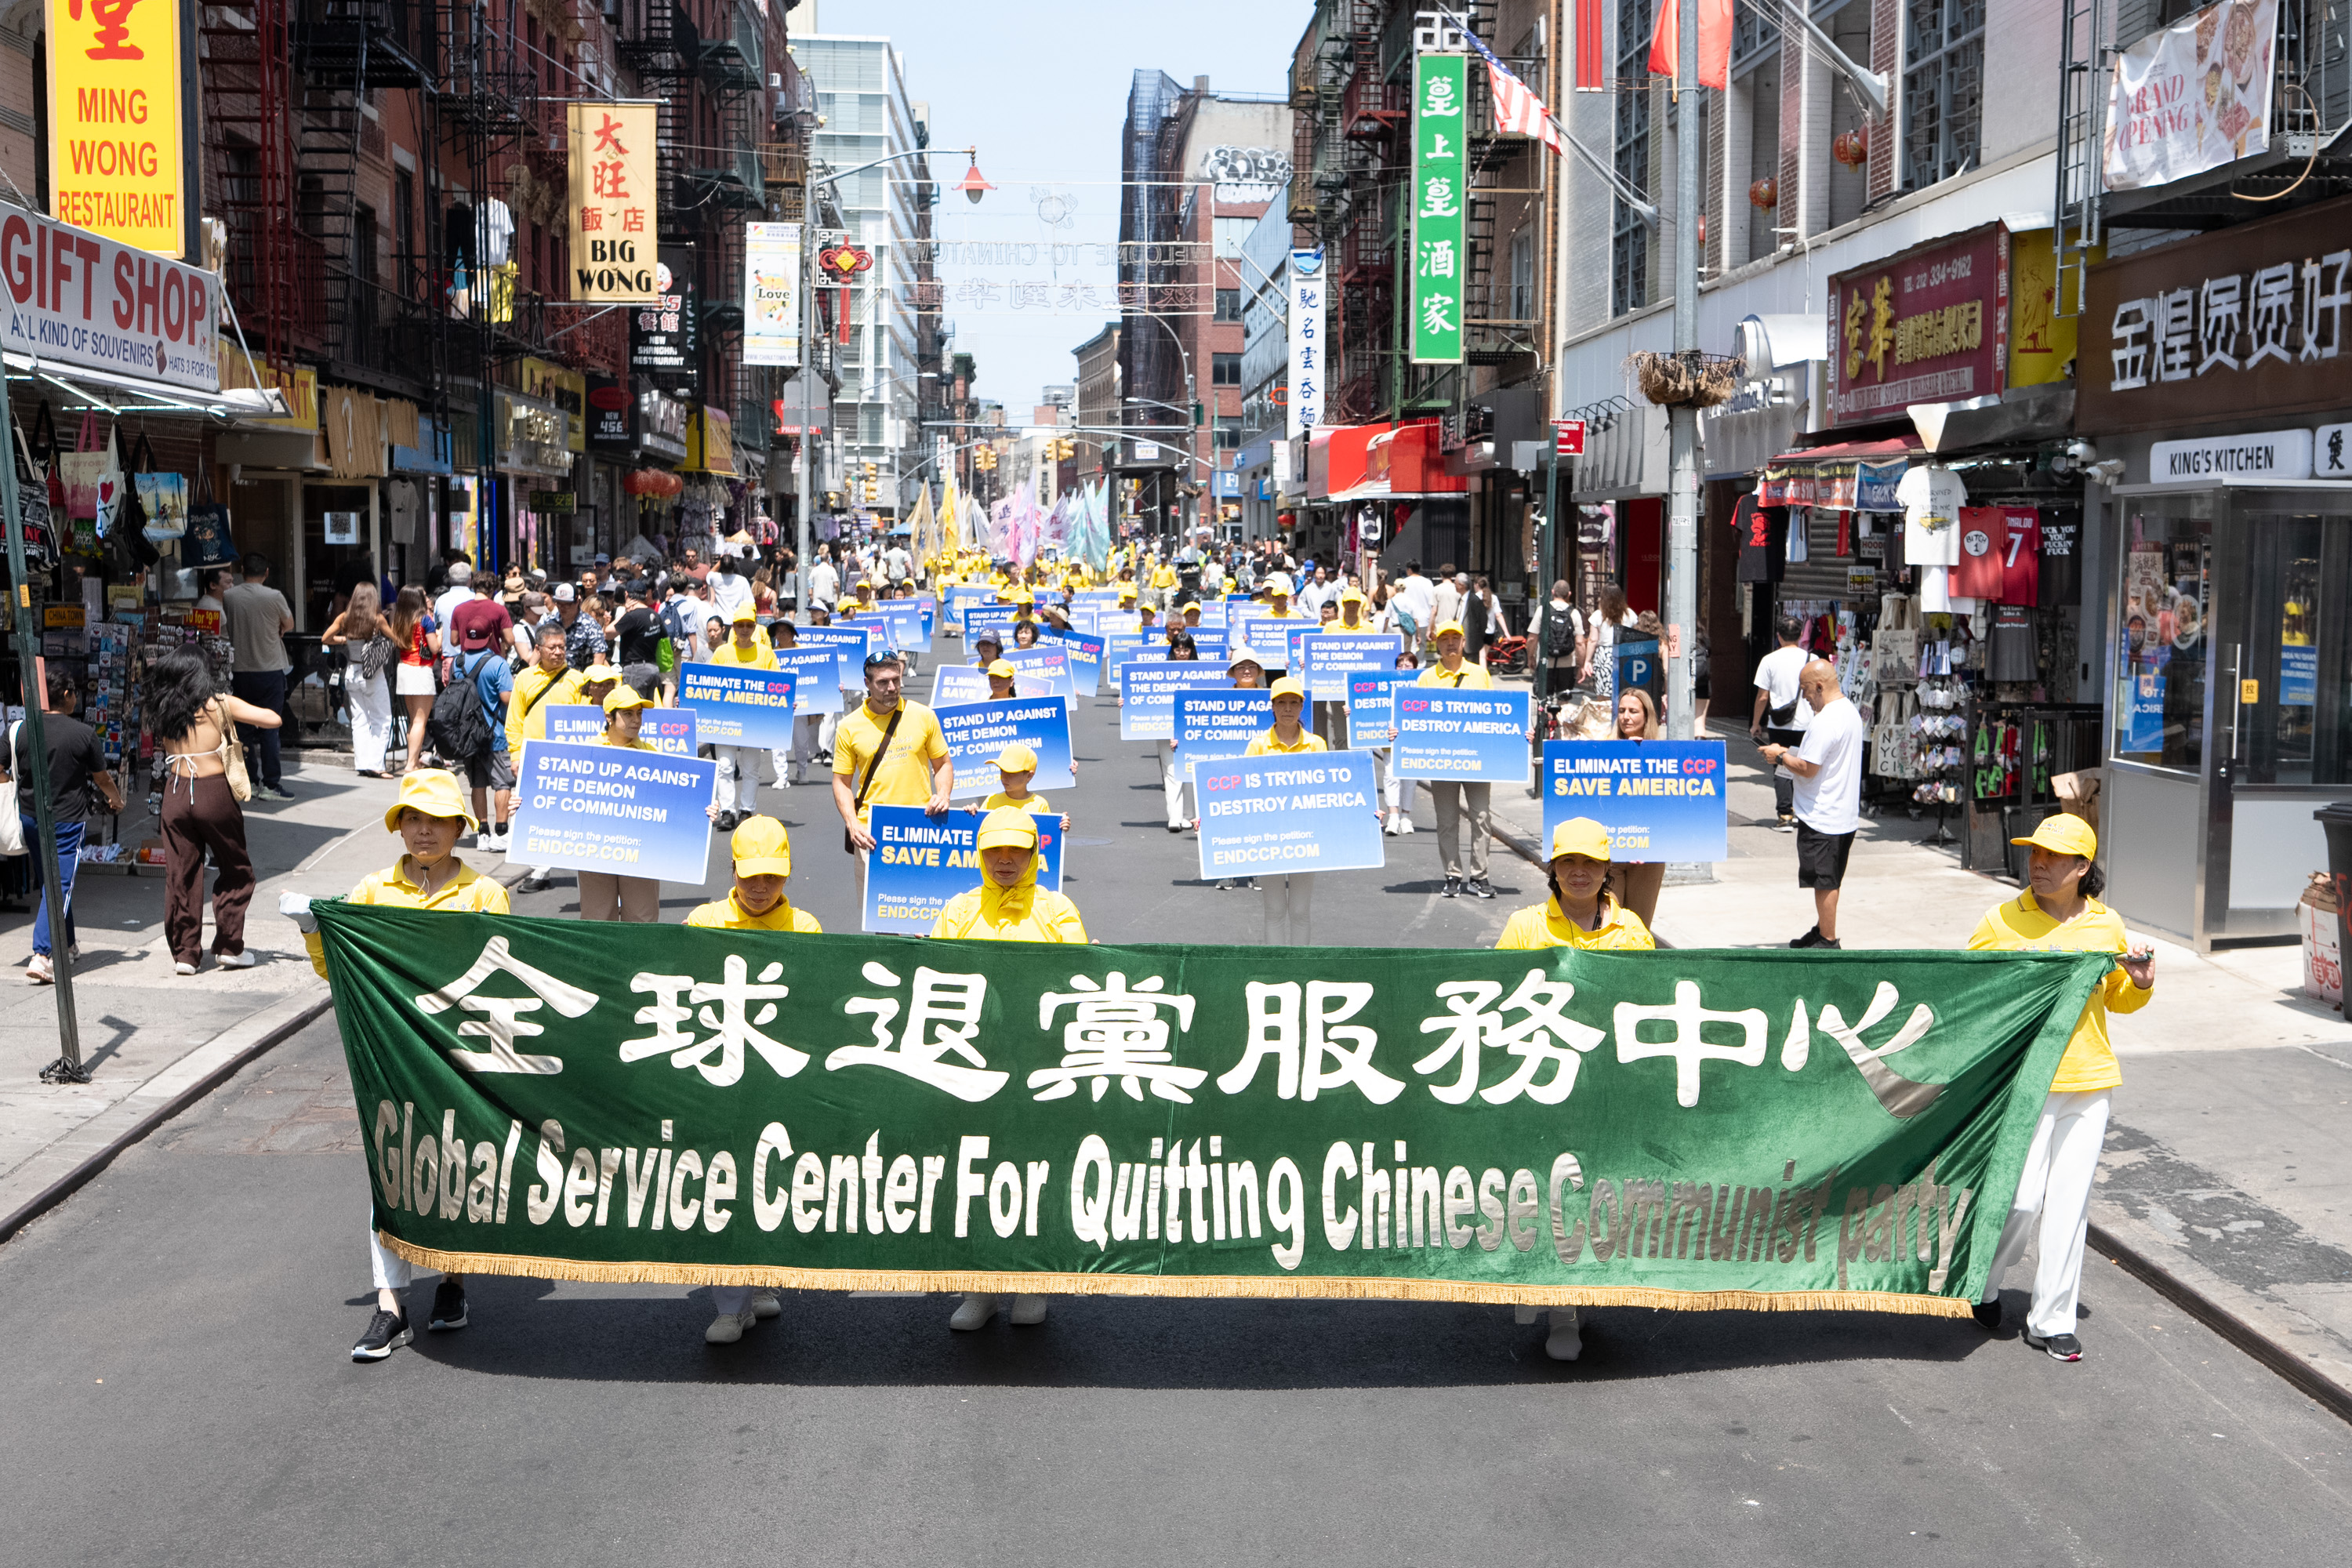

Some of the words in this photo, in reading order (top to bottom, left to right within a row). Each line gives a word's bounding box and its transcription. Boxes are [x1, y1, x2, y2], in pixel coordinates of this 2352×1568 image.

[2125, 74, 2184, 118] GRAND
[78, 88, 147, 124] MING
[71, 140, 157, 176] WONG
[592, 113, 630, 199] 大旺
[60, 191, 174, 227] RESTAURANT
[580, 206, 644, 233] 飯店
[591, 240, 635, 263] BIG
[1916, 272, 1927, 288] 212
[1929, 254, 1972, 287] 334-9162
[1, 215, 100, 321] GIFT
[113, 250, 206, 346] SHOP
[577, 269, 652, 293] WONG
[758, 288, 790, 299] Love
[2111, 249, 2352, 391] 金煌煲煲好
[11, 314, 35, 343] ALL
[40, 318, 68, 348] KIND
[72, 327, 88, 355] OF
[92, 335, 154, 368] SOUVENIRS
[649, 336, 666, 345] NEW
[637, 346, 678, 355] SHANGHAI
[169, 355, 184, 372] HATS
[186, 359, 191, 372] 3
[191, 361, 205, 376] FOR
[206, 365, 216, 380] $10
[633, 356, 684, 366] RESTAURANT
[605, 412, 619, 420] NEW
[600, 421, 623, 432] 456
[1558, 423, 1579, 431] STANDING
[2170, 449, 2212, 475] KING'S
[2215, 445, 2274, 472] KITCHEN
[2005, 516, 2033, 528] ONALDO
[1966, 533, 1987, 543] BITCH
[1974, 543, 1979, 552] 1
[2006, 532, 2024, 568] 7
[49, 609, 66, 620] CHINA
[67, 608, 84, 620] TOWN
[194, 610, 205, 624] for
[811, 633, 822, 643] UP
[823, 634, 862, 644] AGAINST
[1065, 639, 1081, 650] THE
[1083, 643, 1101, 653] CCP
[1311, 642, 1339, 651] STAND
[1356, 642, 1395, 651] AGAINST
[792, 654, 830, 666] AGAINST
[1025, 657, 1044, 668] THE
[1045, 655, 1065, 666] CCP
[1311, 652, 1327, 661] THE
[1329, 652, 1363, 661] DEMON
[1312, 662, 1323, 671] OF
[1325, 662, 1381, 671] COMMUNISM
[1632, 659, 1647, 682] P
[686, 673, 741, 690] ELIMINATE
[744, 680, 765, 691] THE
[768, 682, 791, 694] CCP
[1130, 671, 1163, 681] STAND
[1166, 671, 1179, 681] UP
[1181, 670, 1226, 681] AGAINST
[942, 688, 976, 699] SAVE
[1130, 684, 1149, 692] THE
[1152, 683, 1190, 692] DEMON
[1354, 682, 1376, 693] CCP
[1377, 681, 1388, 691] IS
[2245, 684, 2255, 695] 拉
[684, 687, 720, 702] SAVE
[724, 690, 788, 708] AMERICA
[1184, 700, 1227, 712] STAND
[1230, 700, 1245, 712] UP
[1402, 700, 1428, 713] CCP
[1431, 700, 1443, 713] IS
[1446, 701, 1492, 715] TRYING
[1494, 702, 1512, 715] TO
[944, 713, 983, 729] STAND
[988, 712, 1005, 724] UP
[1007, 707, 1058, 722] AGAINST
[1185, 715, 1210, 727] THE
[1212, 715, 1257, 727] DEMON
[661, 723, 689, 736] CCP
[946, 730, 969, 743] THE
[972, 725, 1018, 741] DEMON
[1185, 729, 1202, 741] OF
[1401, 719, 1463, 733] DESTROY
[1465, 720, 1521, 735] AMERICA
[1401, 746, 1424, 755] Please
[1425, 747, 1439, 756] sign
[1401, 757, 1482, 771] ENDCCP.COM
[1554, 758, 1641, 773] ELIMINATE
[1645, 759, 1678, 773] THE
[1682, 759, 1716, 774] CCP
[539, 757, 594, 775] STAND
[599, 762, 622, 778] UP
[625, 765, 700, 788] AGAINST
[1207, 775, 1241, 792] CCP
[1245, 773, 1261, 789] IS
[1265, 769, 1326, 787] TRYING
[1328, 768, 1352, 783] TO
[536, 775, 568, 793] THE
[573, 779, 635, 800] DEMON
[1554, 778, 1610, 796] SAVE
[1616, 779, 1715, 796] AMERICA
[533, 795, 556, 810] OF
[561, 797, 667, 823] COMMUNISM
[1209, 796, 1287, 817] DESTROY
[1291, 792, 1367, 811] AMERICA
[529, 826, 561, 838] Please
[564, 828, 583, 842] sign
[586, 831, 601, 843] the
[604, 833, 641, 848] petition:
[881, 826, 973, 846] ELIMINATE
[1211, 834, 1239, 846] Please
[1240, 833, 1261, 844] sign
[1264, 832, 1278, 842] the
[1279, 829, 1314, 843] petition:
[527, 838, 639, 863] ENDCCP.COM
[880, 846, 940, 866] SAVE
[1214, 843, 1320, 866] ENDCCP.COM
[878, 894, 907, 905] Please
[909, 895, 927, 906] sign
[929, 896, 943, 906] the
[415, 935, 1946, 1119] 全球退黨服務中心
[374, 1099, 524, 1225] Global
[528, 1119, 739, 1234] Service
[753, 1121, 946, 1236] Center
[955, 1134, 1050, 1239] For
[1071, 1134, 1305, 1271] Quitting
[1322, 1139, 1539, 1252] Chinese
[1549, 1152, 1840, 1265] Communist
[1835, 1156, 1973, 1293] party
